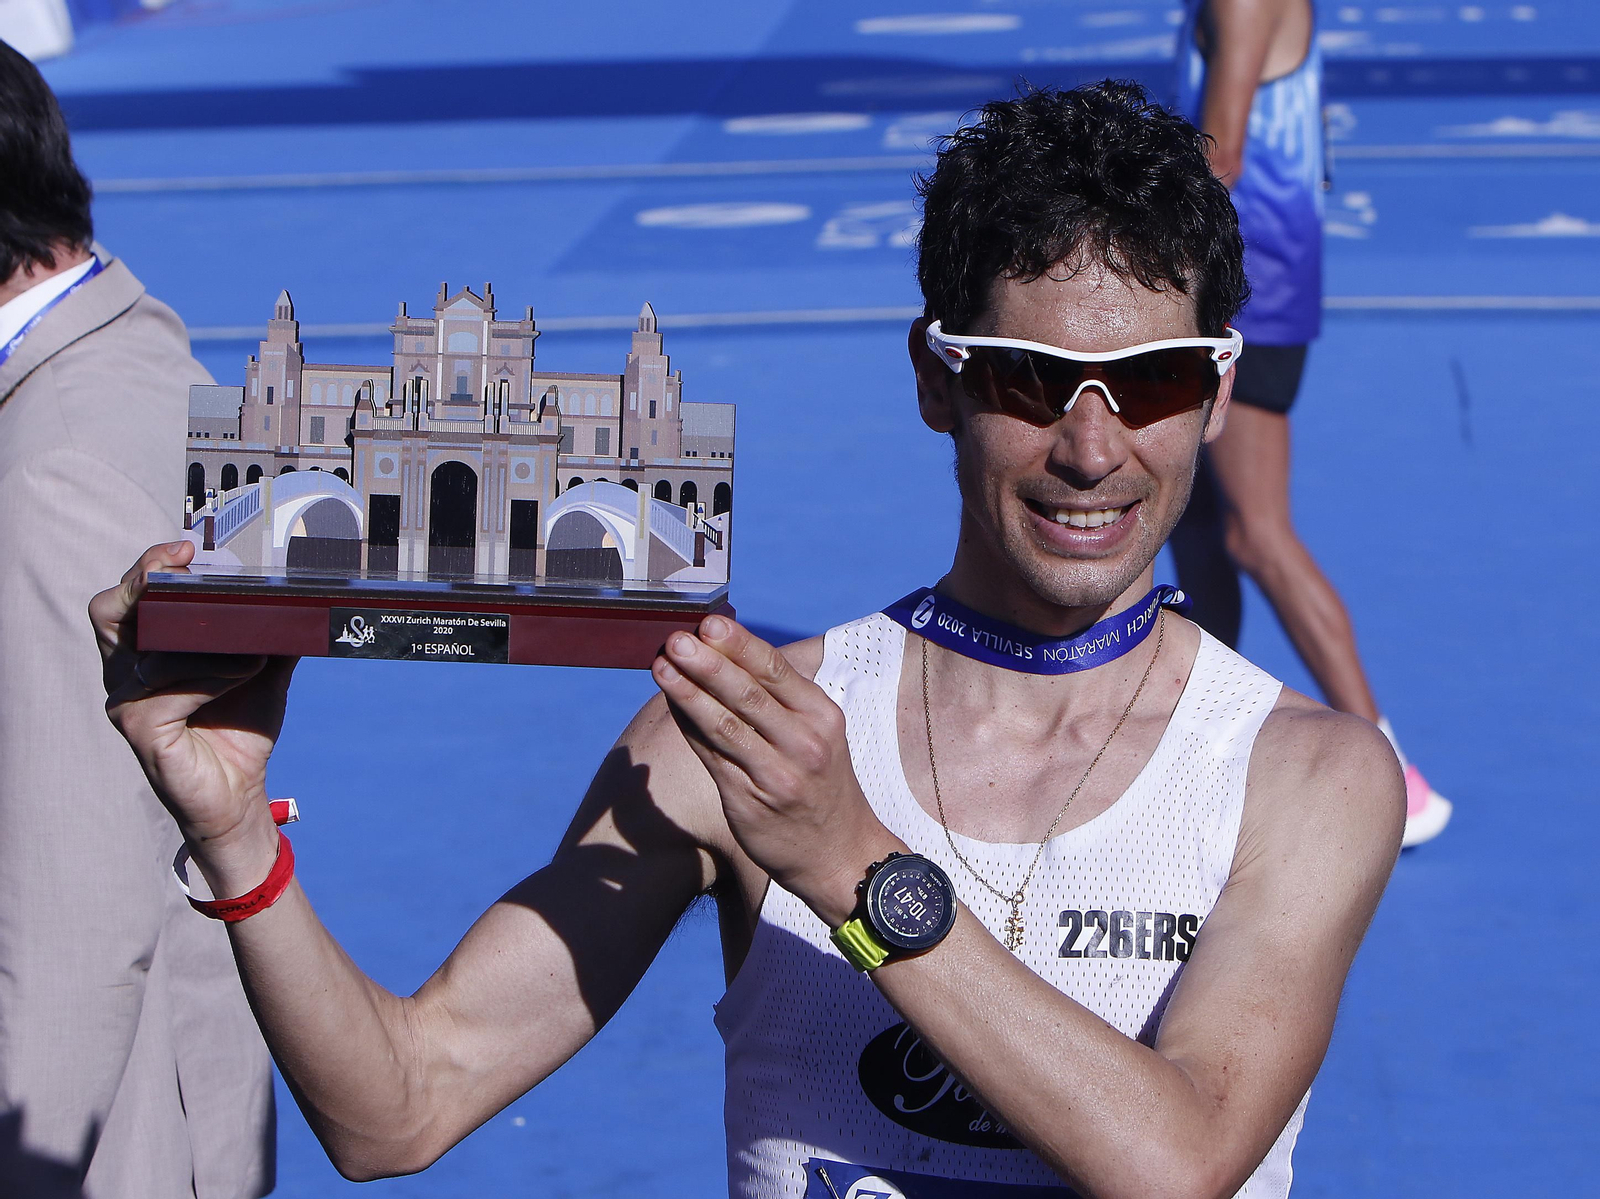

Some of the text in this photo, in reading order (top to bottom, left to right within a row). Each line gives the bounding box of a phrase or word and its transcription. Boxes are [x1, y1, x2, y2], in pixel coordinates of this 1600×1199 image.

[380, 615, 507, 628] XXXVI Zurich Maratón De Sevilla
[433, 626, 453, 635] 2020
[937, 611, 966, 637] 2020
[424, 642, 475, 656] ESPAÑOL
[972, 626, 1033, 660] SEVILLA
[1043, 629, 1120, 664] MARATÓN
[893, 886, 927, 921] 10:47
[1058, 910, 1199, 962] 226ERS
[968, 1110, 991, 1132] de
